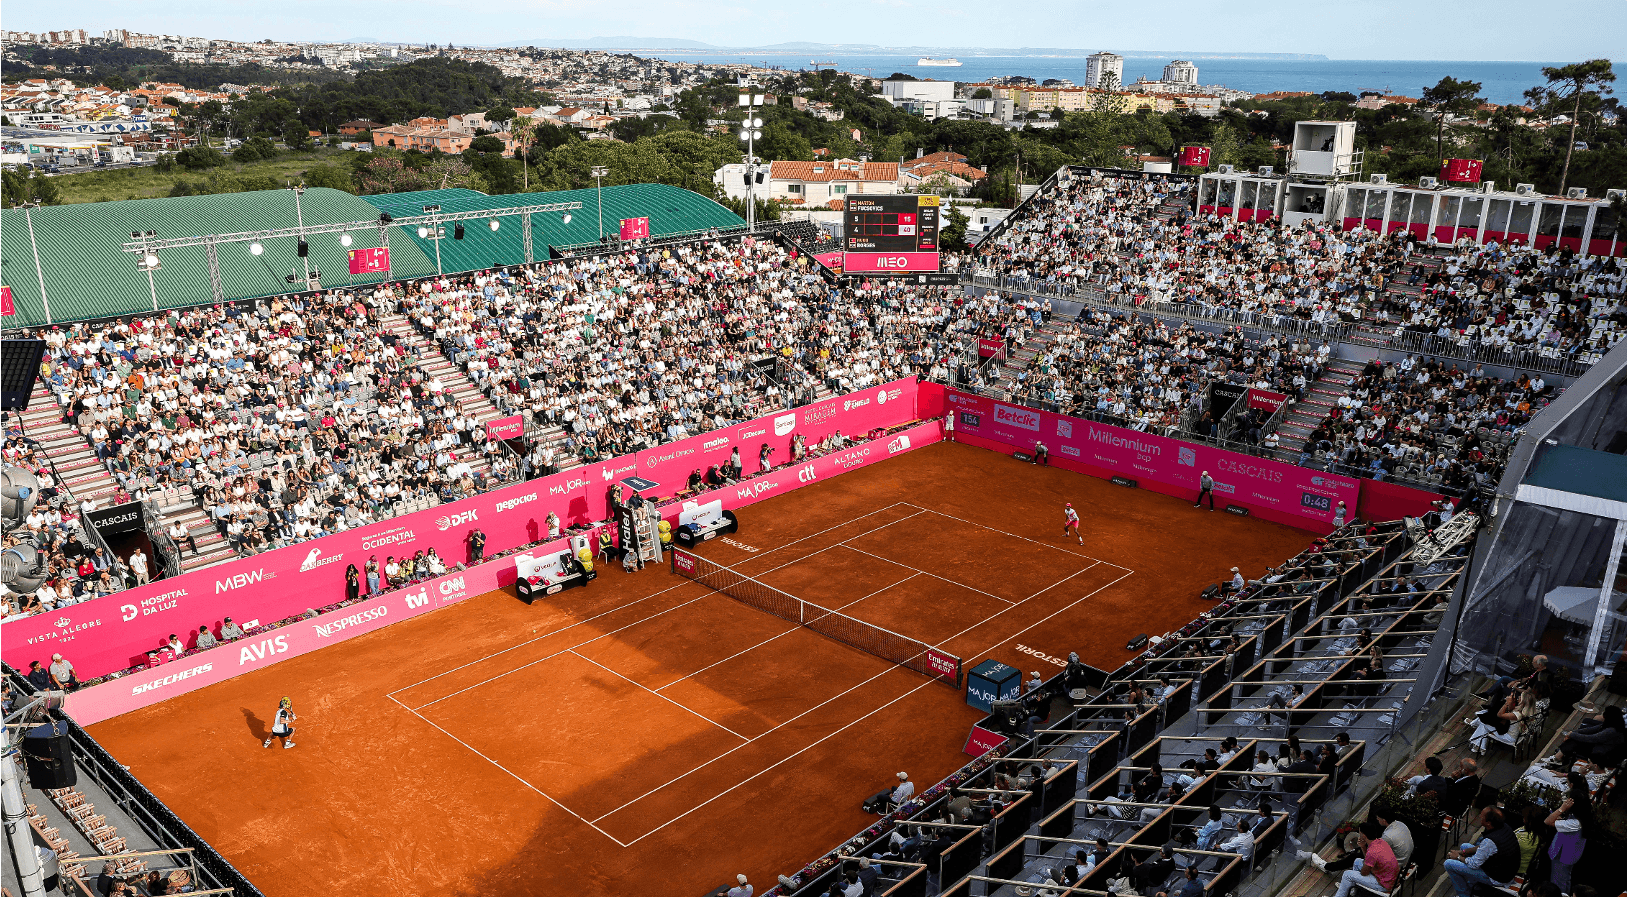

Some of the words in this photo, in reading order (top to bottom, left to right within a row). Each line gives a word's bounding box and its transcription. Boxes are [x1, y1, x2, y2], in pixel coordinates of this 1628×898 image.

[1465, 170, 1470, 178] 2
[374, 249, 379, 257] 4
[877, 256, 908, 268] MEO
[1214, 389, 1243, 399] CASCAI
[963, 414, 978, 425] 154
[996, 407, 1037, 428] Betclic
[1088, 425, 1161, 456] Millennium
[834, 448, 871, 465] ALTANO
[1137, 452, 1152, 463] bcp
[798, 464, 817, 483] ctt
[1217, 458, 1283, 484] CASCAIS
[549, 478, 582, 495] MAJOR
[737, 480, 770, 499] MAJOR
[1304, 494, 1329, 508] 0:48
[94, 511, 138, 528] CASCAIS
[451, 508, 479, 528] DFK
[362, 529, 416, 551] OCIDENTAL
[622, 511, 633, 552] Haier
[215, 567, 264, 595] MBW
[439, 576, 466, 595] CNN
[140, 588, 189, 608] HOSPITAL
[404, 586, 429, 609] tvi
[143, 606, 158, 616] DA
[158, 599, 178, 613] LUZ
[312, 605, 388, 638] NESPRESSO
[27, 631, 59, 645] VISTA
[62, 618, 102, 636] ALEGRE
[239, 634, 289, 666] AVIS
[131, 662, 213, 697] SKECHERS
